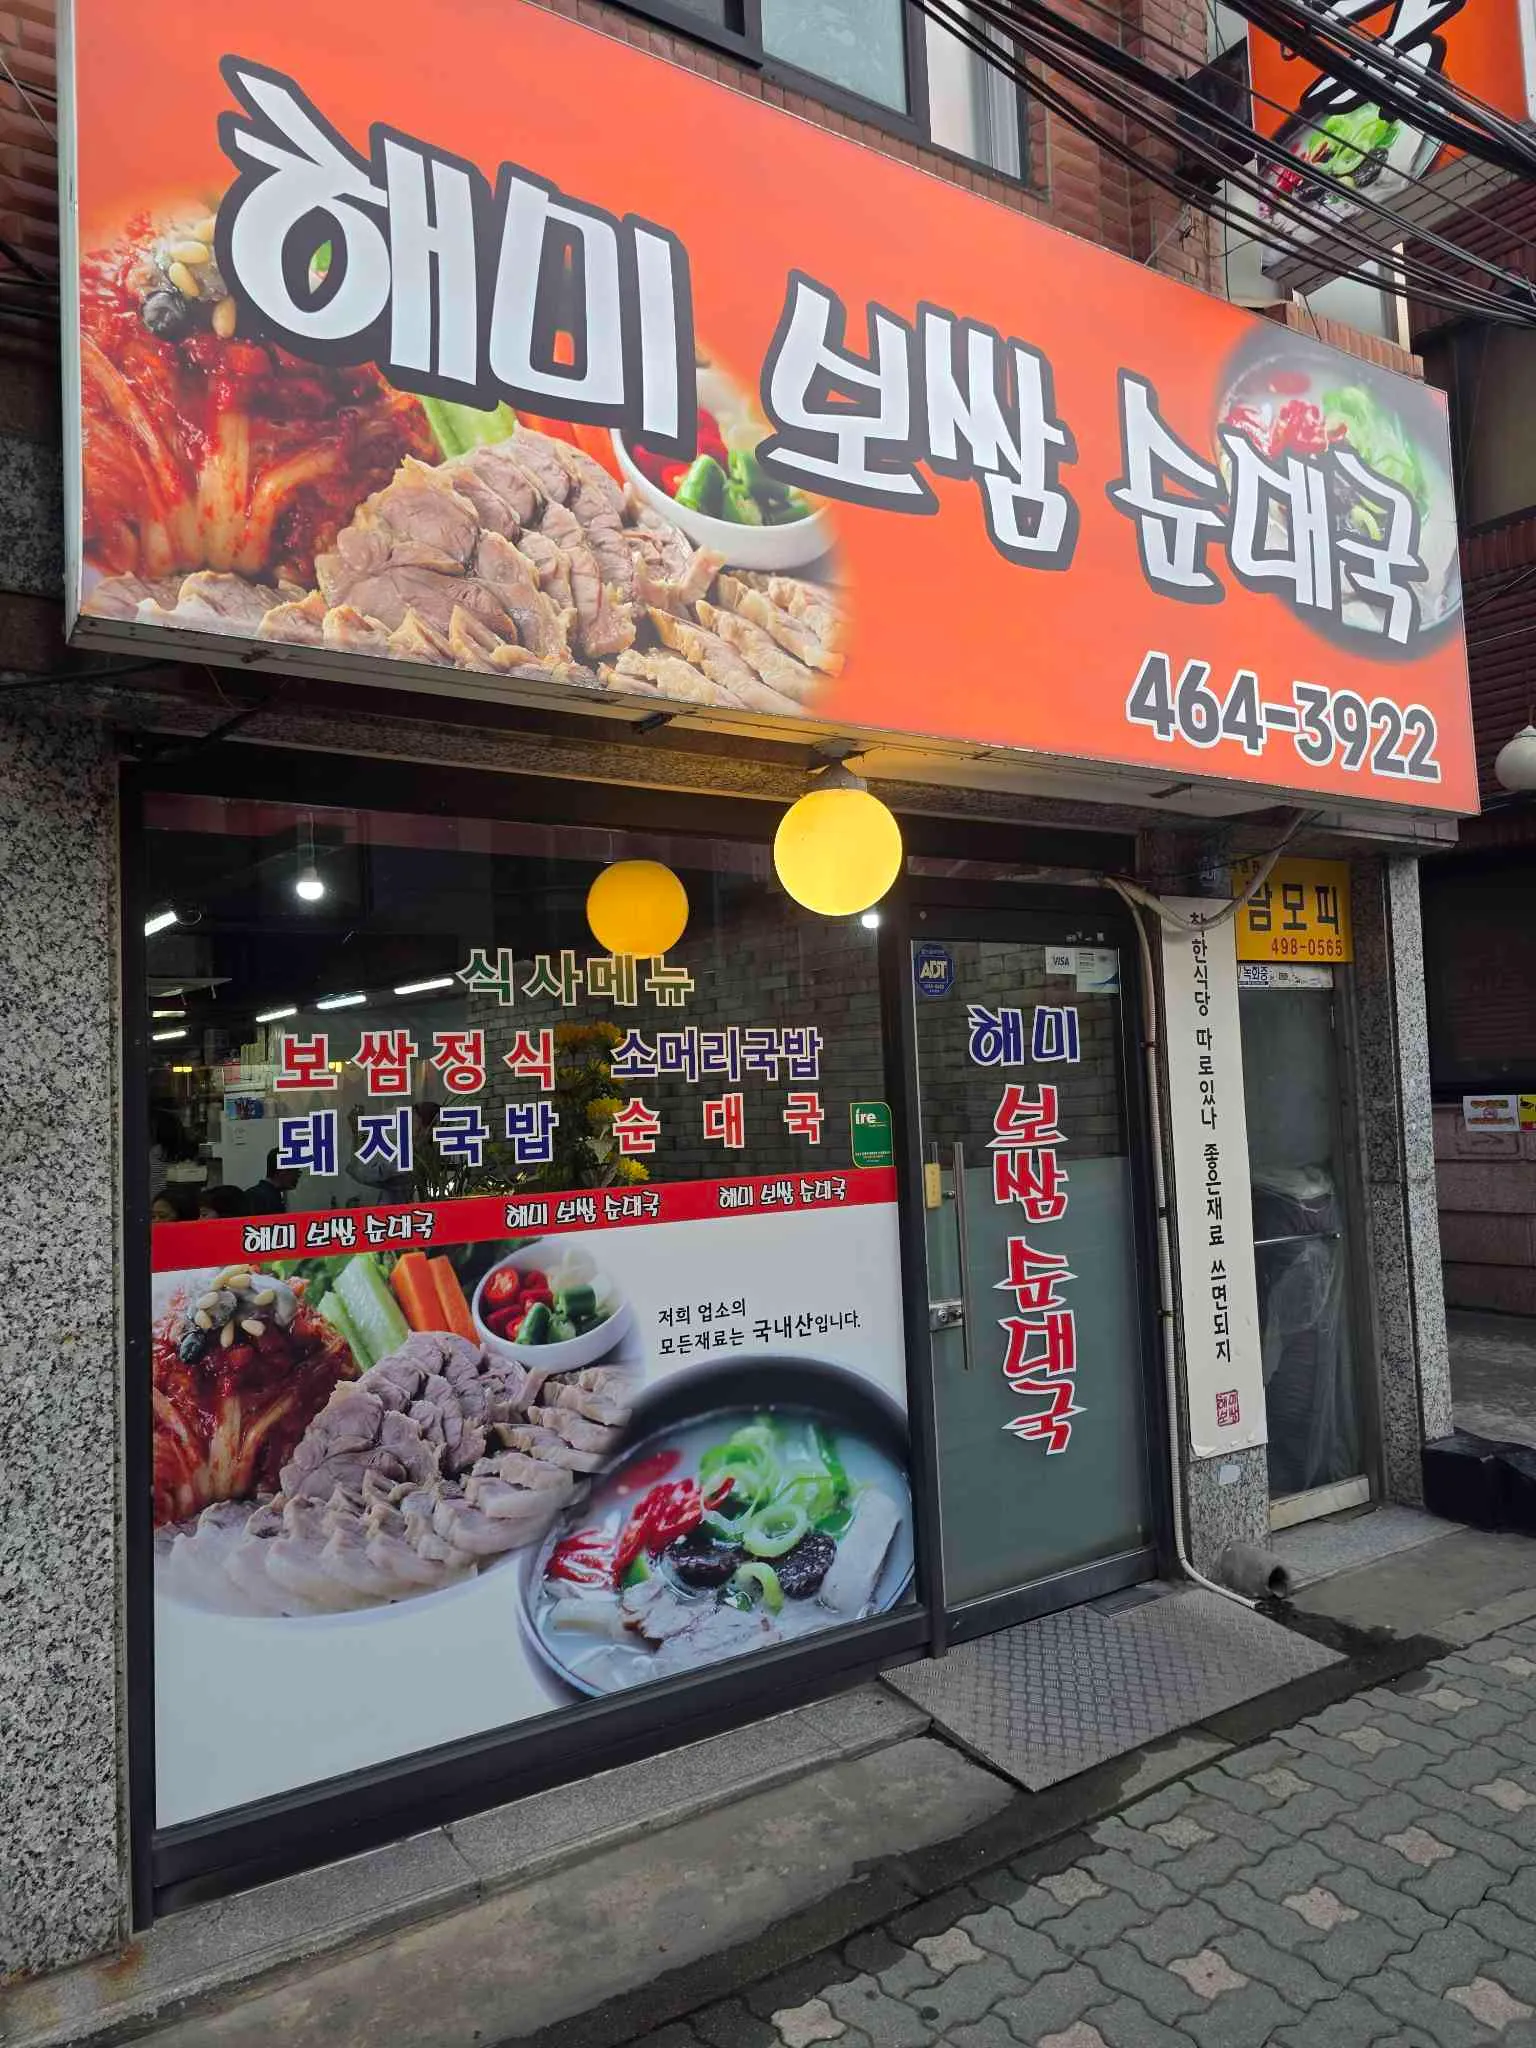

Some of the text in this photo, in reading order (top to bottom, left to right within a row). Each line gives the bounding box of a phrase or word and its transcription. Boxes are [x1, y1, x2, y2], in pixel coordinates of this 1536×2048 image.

[222, 60, 1423, 648] 해미 보쌈 순대국
[1127, 651, 1441, 783] 464-3922
[920, 960, 948, 979] ADT
[1053, 955, 1070, 966] VISA
[1271, 937, 1344, 956] 498-0565
[456, 948, 694, 1006] 식사메뉴
[273, 1029, 555, 1096] 보쌈정식
[610, 1026, 823, 1083] 소머리국밥
[966, 1004, 1080, 1066] 해미
[1196, 1027, 1217, 1130] 따로있나
[277, 1100, 559, 1177] 돼지국밥
[612, 1092, 824, 1155] 순대국
[506, 1191, 659, 1229] 해미 보쌈 순대국
[718, 1177, 847, 1208] 해미 보쌈 순대국
[1203, 1143, 1225, 1246] 좋은재료
[243, 1210, 434, 1253] 해미 보쌈 순대국
[984, 1083, 1088, 1455] 보쌈 순대국
[658, 1298, 746, 1327] 저희 업소의
[659, 1310, 861, 1354] 모든재료는 국내산입니다.
[1210, 1259, 1232, 1363] 쓰면되지
